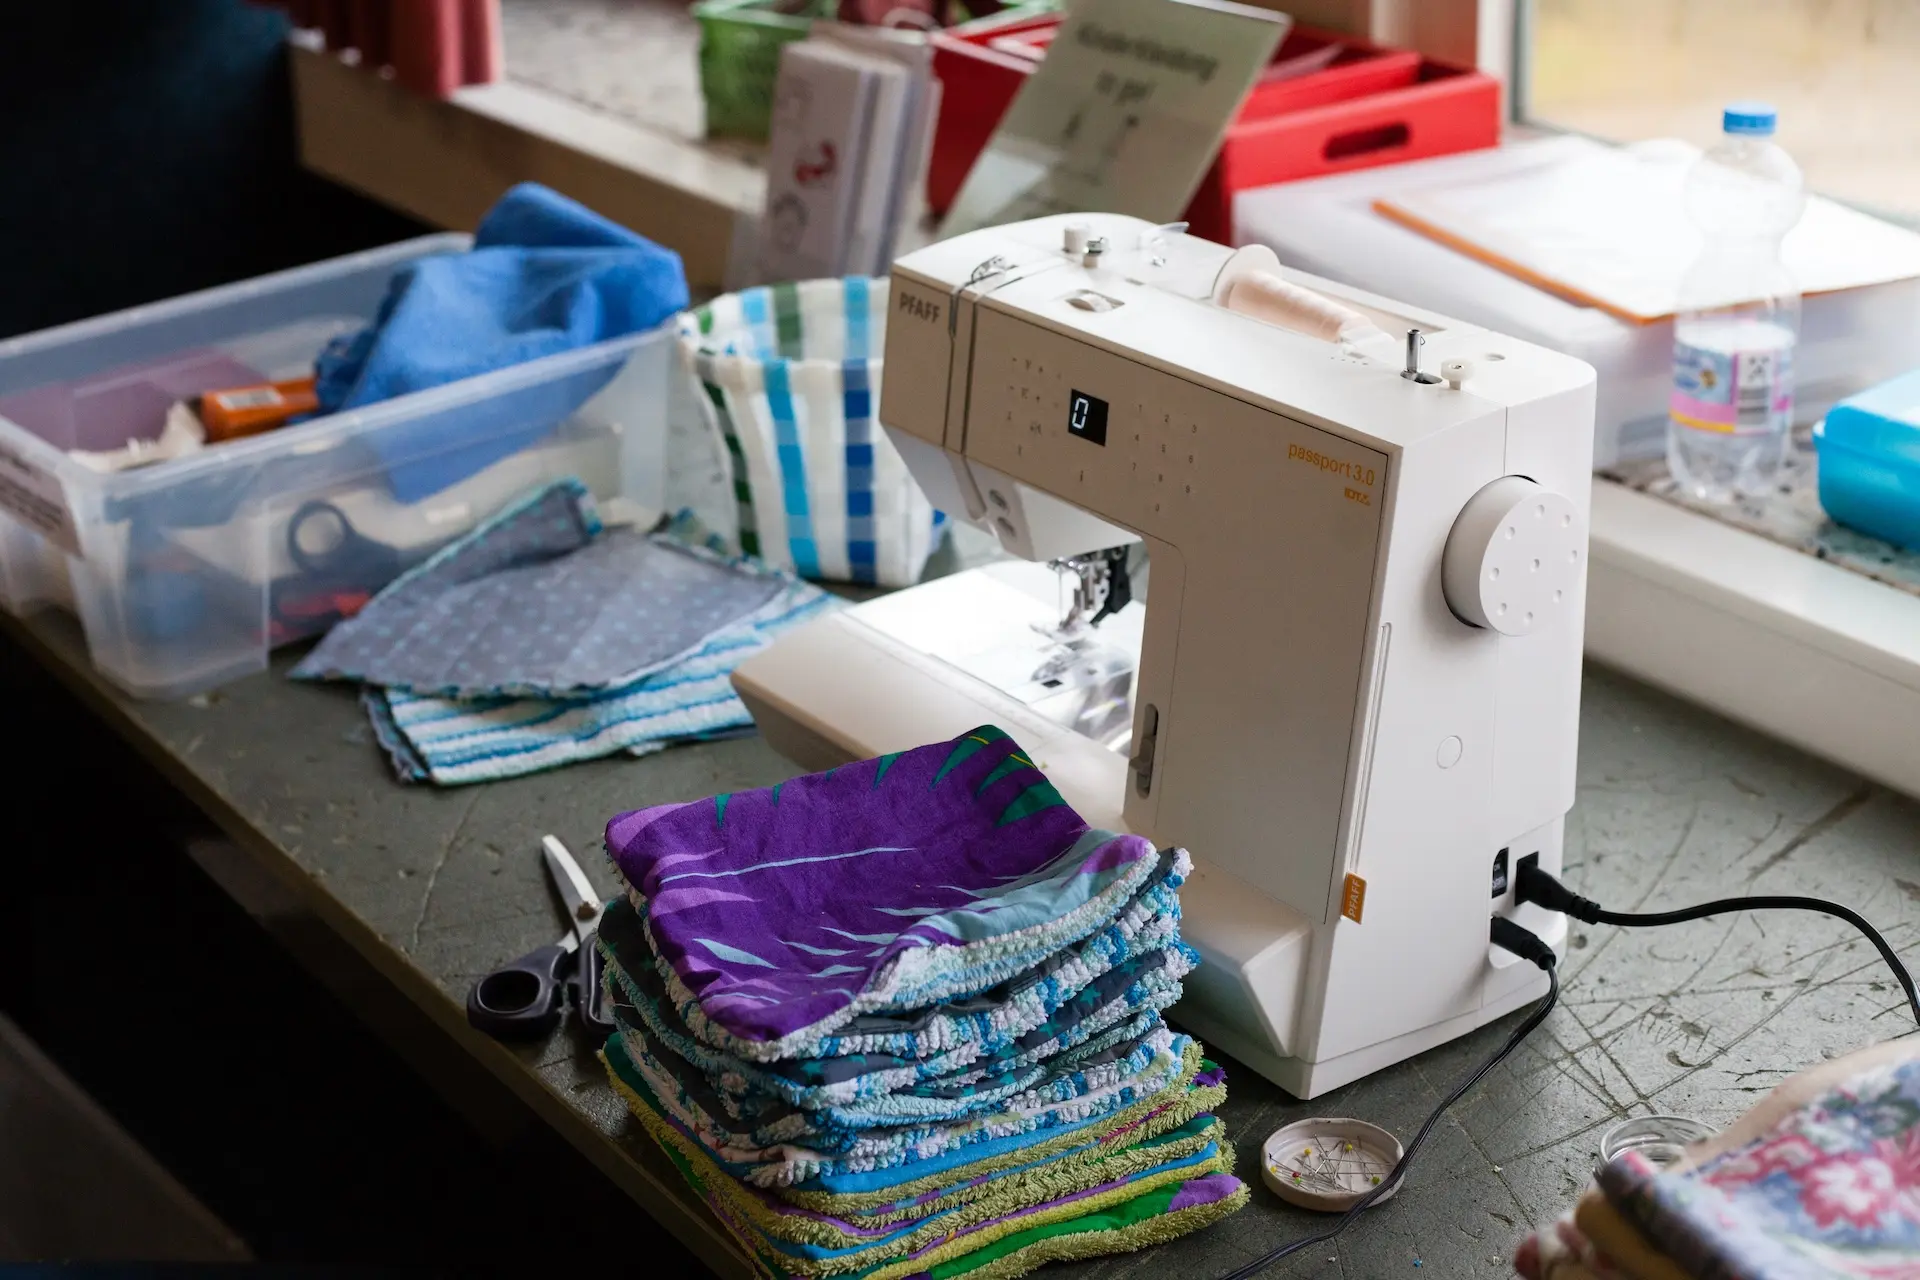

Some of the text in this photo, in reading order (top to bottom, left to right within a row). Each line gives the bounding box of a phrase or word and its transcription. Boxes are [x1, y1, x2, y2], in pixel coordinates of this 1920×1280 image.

[900, 291, 940, 323] PFAFF
[1072, 397, 1089, 429] 0
[1288, 443, 1375, 486] passport 3.0
[1348, 878, 1361, 918] PFAFF
